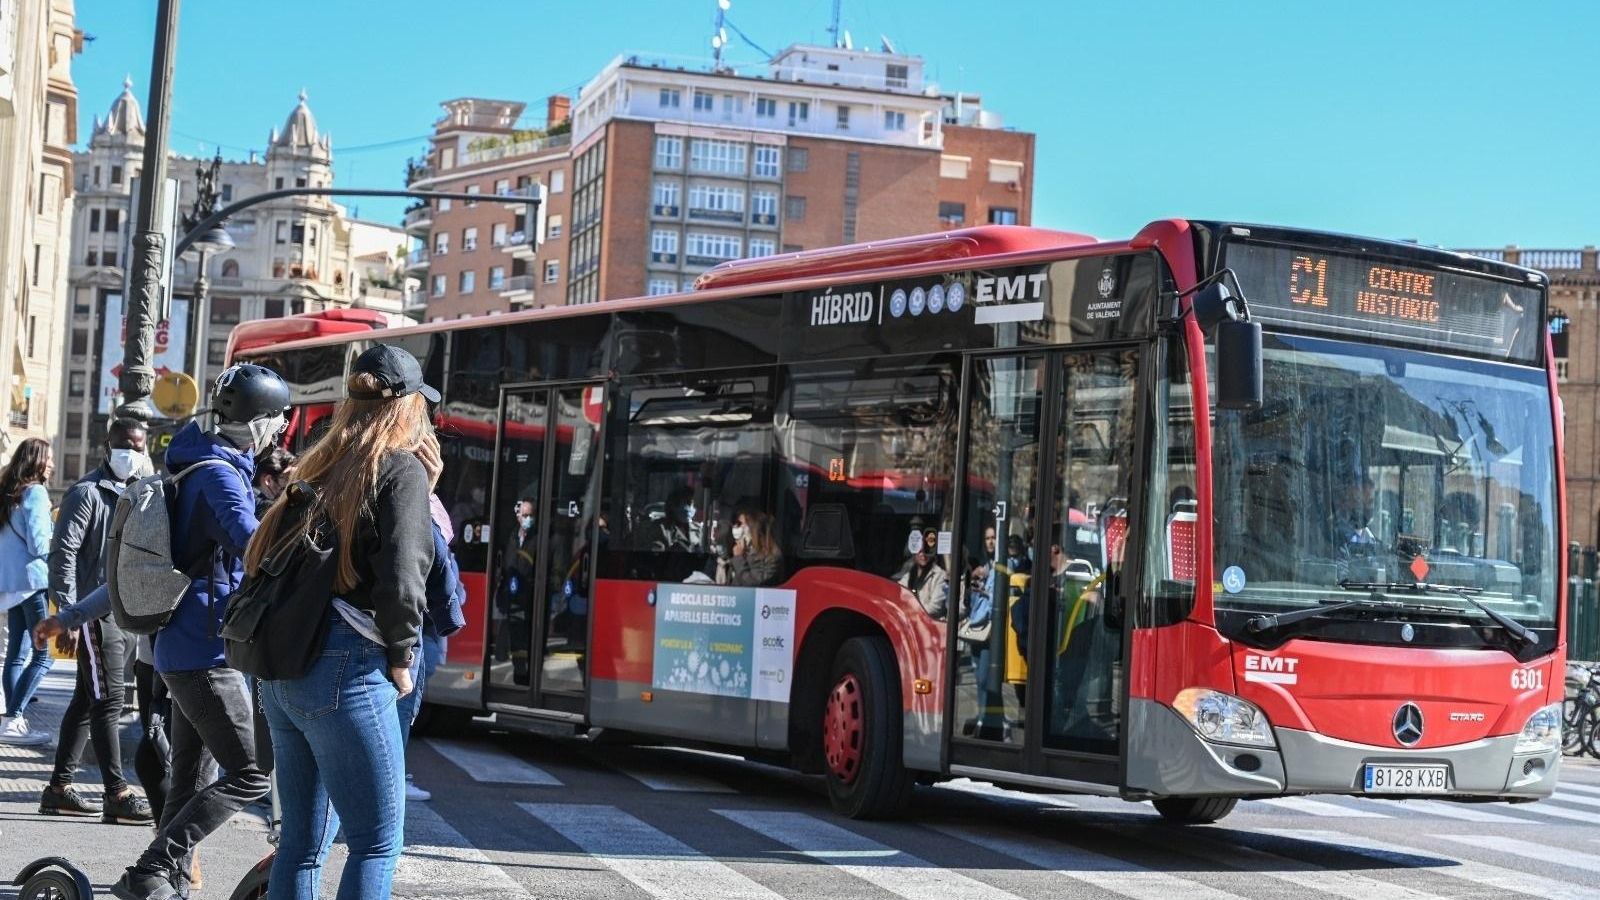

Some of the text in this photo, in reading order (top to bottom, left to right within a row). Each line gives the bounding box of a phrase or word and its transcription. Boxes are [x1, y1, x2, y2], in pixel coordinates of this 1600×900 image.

[976, 273, 1047, 302] EMT
[1290, 255, 1329, 307] C1
[1368, 266, 1435, 296] CENTRE
[811, 287, 873, 326] HÍBRID
[1086, 312, 1094, 320] DE
[1087, 301, 1122, 311] AJUNTAMENT
[1356, 290, 1440, 322] HISTORIC
[829, 458, 846, 481] C1
[670, 592, 737, 608] RECICLA ELS TEUS
[664, 609, 700, 624] APARELLS
[1245, 655, 1299, 673] EMT
[1511, 668, 1543, 690] 6301
[1375, 769, 1444, 787] 8128 KXB
